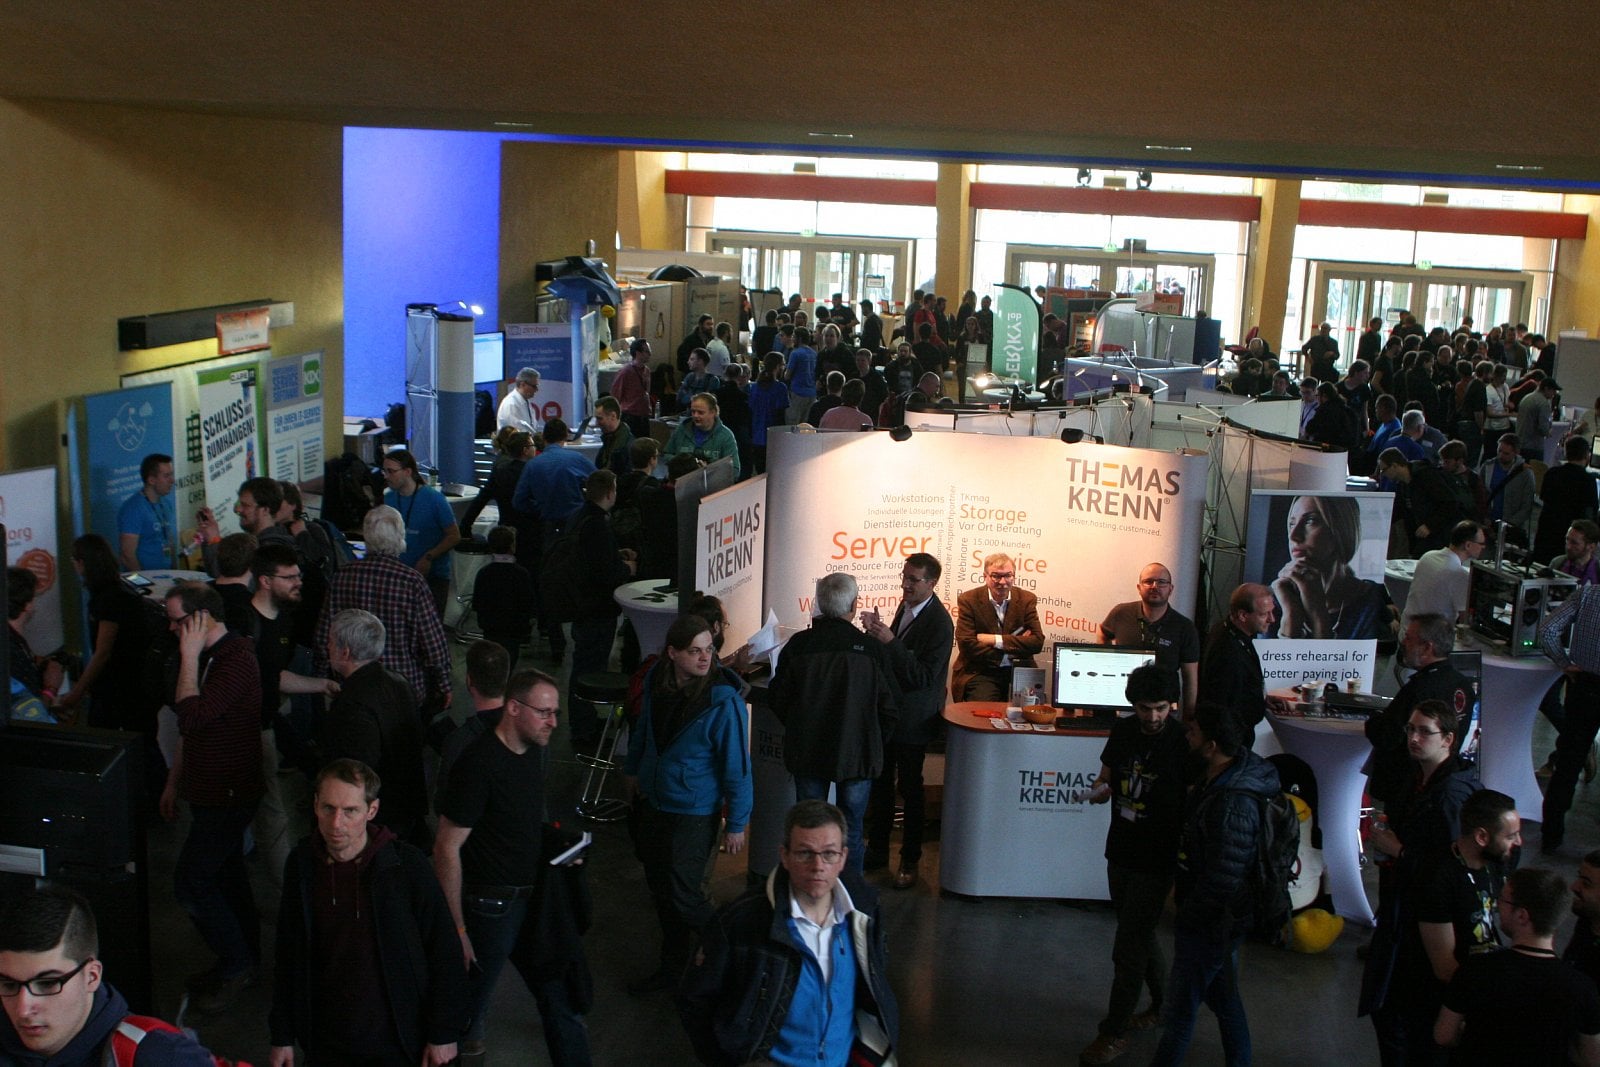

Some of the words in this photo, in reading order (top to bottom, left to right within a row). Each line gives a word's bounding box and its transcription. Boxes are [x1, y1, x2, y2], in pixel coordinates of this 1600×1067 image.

[203, 399, 244, 441] SCHLUSS
[882, 494, 945, 504] Workstations
[960, 503, 1027, 525] Storage
[864, 519, 944, 530] Dienstleistungen
[959, 521, 976, 531] Vor
[977, 522, 993, 532] Ort
[996, 523, 1042, 537] Beratung
[831, 531, 932, 560] Server
[1001, 540, 1031, 549] Kunden
[957, 537, 968, 582] Webinare
[825, 563, 849, 574] Open
[851, 562, 882, 571] Source
[1045, 610, 1097, 633] Beratu
[1262, 650, 1292, 662] dress
[1295, 650, 1348, 662] rehearsal
[1351, 651, 1369, 662] for
[1263, 668, 1299, 679] better
[1302, 668, 1338, 681] paying
[1340, 669, 1362, 681] job.
